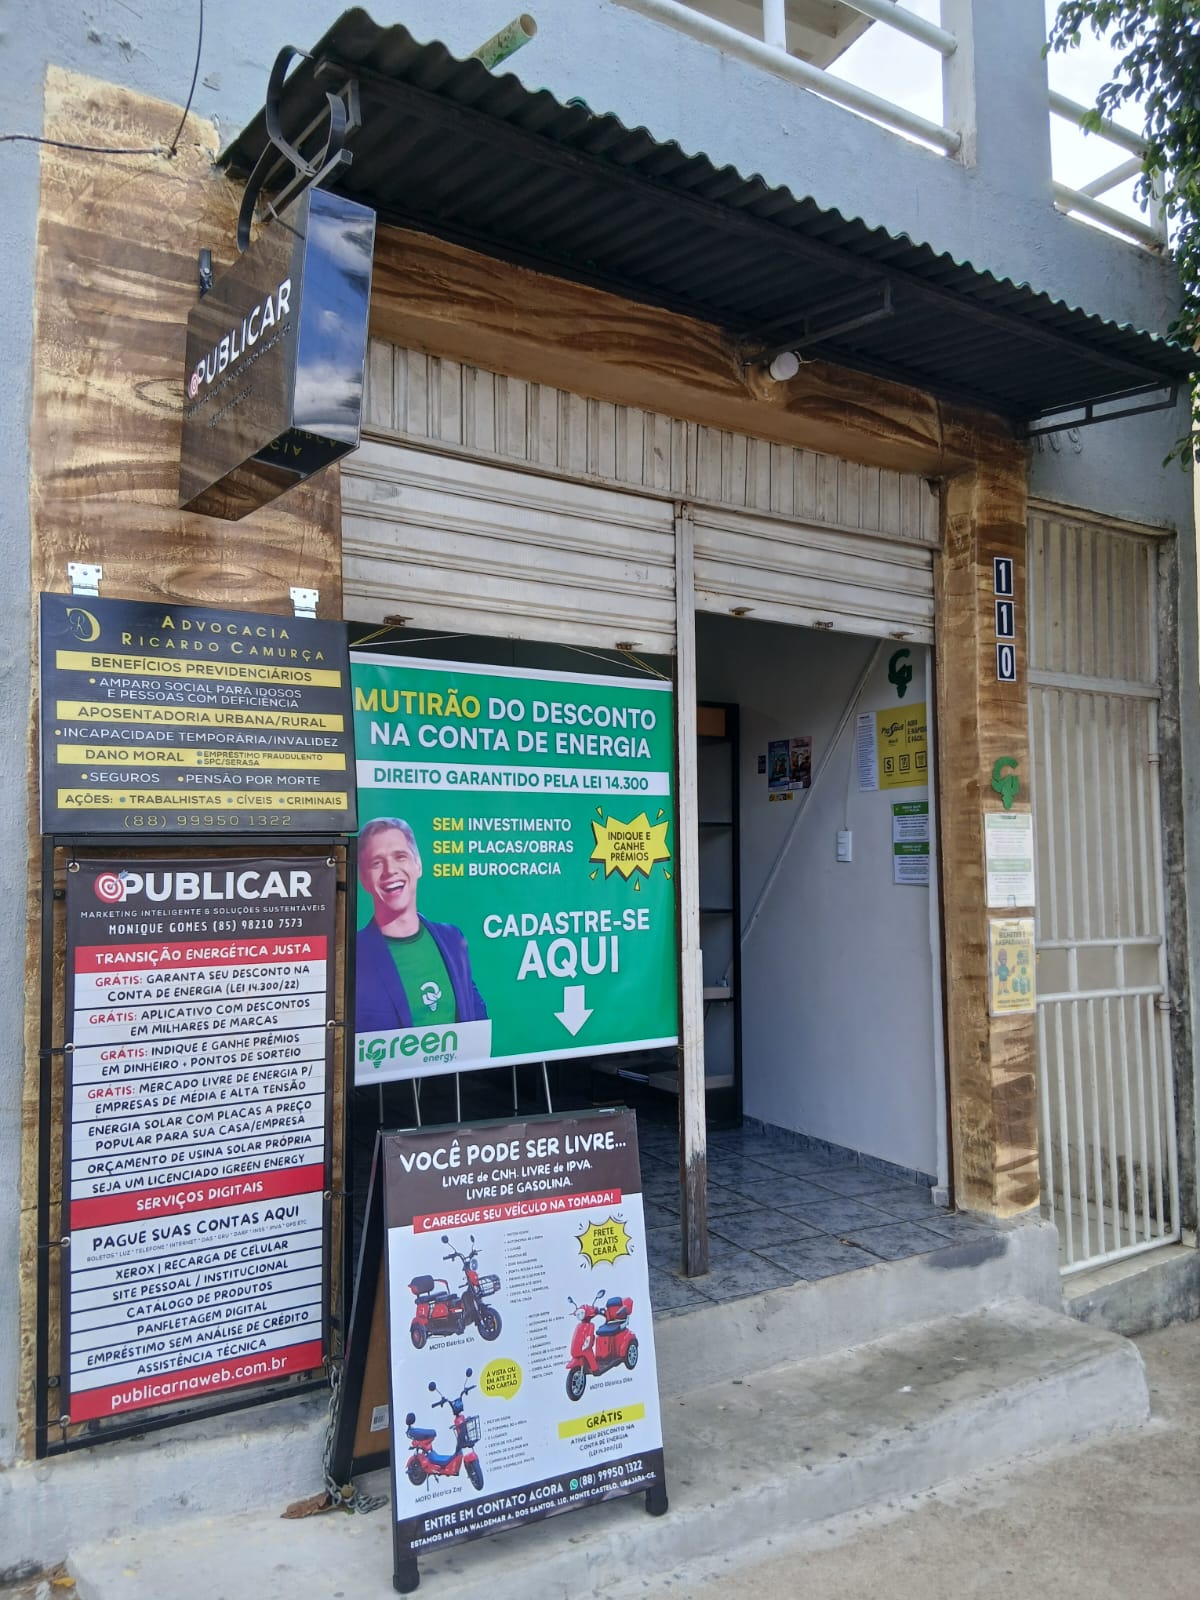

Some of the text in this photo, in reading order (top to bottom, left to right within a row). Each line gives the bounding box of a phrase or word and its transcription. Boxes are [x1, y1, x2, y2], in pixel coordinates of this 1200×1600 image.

[196, 278, 291, 384] PUBLICAR
[162, 616, 289, 639] ADVOCACIA
[121, 632, 325, 662] RICARDO CAMURÇA
[91, 656, 312, 682] BENEFÍCIOS PREVIDENCIÁRIOS
[100, 678, 302, 698] AMPARO SOCIAL PARA IDOSOS
[108, 689, 299, 708] E PESSOAS COM DEFICIÊNCIA
[78, 706, 327, 728] APOSENTADORIA URBANA/RURAL
[355, 688, 657, 730] MUTIRÃO DO DESCONTO
[64, 727, 338, 747] INCAPACIDADE TEMPORÁRIA/INVALIDEZ
[370, 722, 651, 759] NA CONTA DE ENERGIA
[86, 749, 184, 762] DANO MORAL
[203, 750, 323, 761] EMPRÉSTIMO FRAUDULENTO
[204, 758, 260, 766] SPC/SERASA
[91, 772, 160, 784] SEGUROS
[186, 772, 321, 785] PENSÃO POR MORTE
[374, 768, 649, 790] DIREITO GARANTIDO PELA LEI 14.300
[65, 793, 342, 806] AÇÕES: TRABALHISTAS CÍVEIS CRIMINAIS
[125, 815, 293, 827] (88) 99950 1322
[433, 817, 572, 832] SEM INVESTIMENTO
[433, 840, 574, 854] SEM PLACAS/OBRAS
[608, 832, 651, 841] INDIQUE E
[613, 842, 645, 851] GANHE
[610, 850, 649, 862] PRÊMIOS
[433, 862, 561, 877] SEM BUROCRACIA
[120, 871, 312, 902] PUBLICAR
[81, 910, 138, 919] MARKETING
[141, 908, 201, 917] INTELIGENTE
[213, 906, 260, 916] SOLUÇÕES
[263, 904, 326, 913] SUSTENTÁVEIS
[109, 918, 303, 936] MONIQUE GOMES (85) 98210 7573
[483, 908, 650, 939] CADASTRE-SE
[96, 943, 311, 966] TRANSIÇÃO ENERGÉTICA JUSTA
[517, 935, 619, 981] AQUI
[96, 965, 310, 987] GRÁTIS: GARANTA SEU DESCONTO NA
[108, 979, 300, 1001] CONTA DE ENERGIA (LEI 14.300/22)
[89, 999, 310, 1025] GRÁTIS: APLICATIVO COM DESCONTOS
[130, 1015, 278, 1036] EM MILHARES DE MARCAS
[400, 1131, 626, 1173] VOCÊ PODE SER LIVRE...
[443, 1172, 474, 1188] LIVRE
[477, 1172, 489, 1182] de
[522, 1163, 550, 1178] LIVRE
[554, 1163, 564, 1173] de
[567, 1159, 592, 1172] IPVA.
[136, 1181, 264, 1212] SERVIÇOS DIGITAIS
[467, 1177, 573, 1200] LIVRE DE GASOLINA.
[423, 1193, 614, 1229] CARREGUE SEU VEÍCULO NA TOMADA!
[93, 1205, 299, 1251] PAGUE SUAS CONTAS AQUI
[594, 1228, 614, 1237] FRETE
[592, 1234, 618, 1246] GRÁTIS
[593, 1244, 618, 1256] CEARÁ
[115, 1264, 155, 1279] XEROX
[165, 1253, 220, 1271] RECARGA
[224, 1249, 237, 1260] DE
[240, 1240, 288, 1256] CELULAR
[137, 1301, 267, 1335] PANFLETAGEM DIGITAL
[137, 1339, 267, 1375] ASSISTÊNCIA TÉCNICA
[111, 1354, 288, 1409] publicarnaweb.com.br
[587, 1409, 623, 1428] GRÁTIS
[425, 1460, 643, 1532] ENTRE EM CONTATO AGORA (88) 99950 1322
[411, 1534, 442, 1549] ESTAMOS
[444, 1530, 453, 1539] NA
[455, 1526, 468, 1536] RUA
[515, 1508, 528, 1518] DOS
[570, 1489, 590, 1502] MONTE
